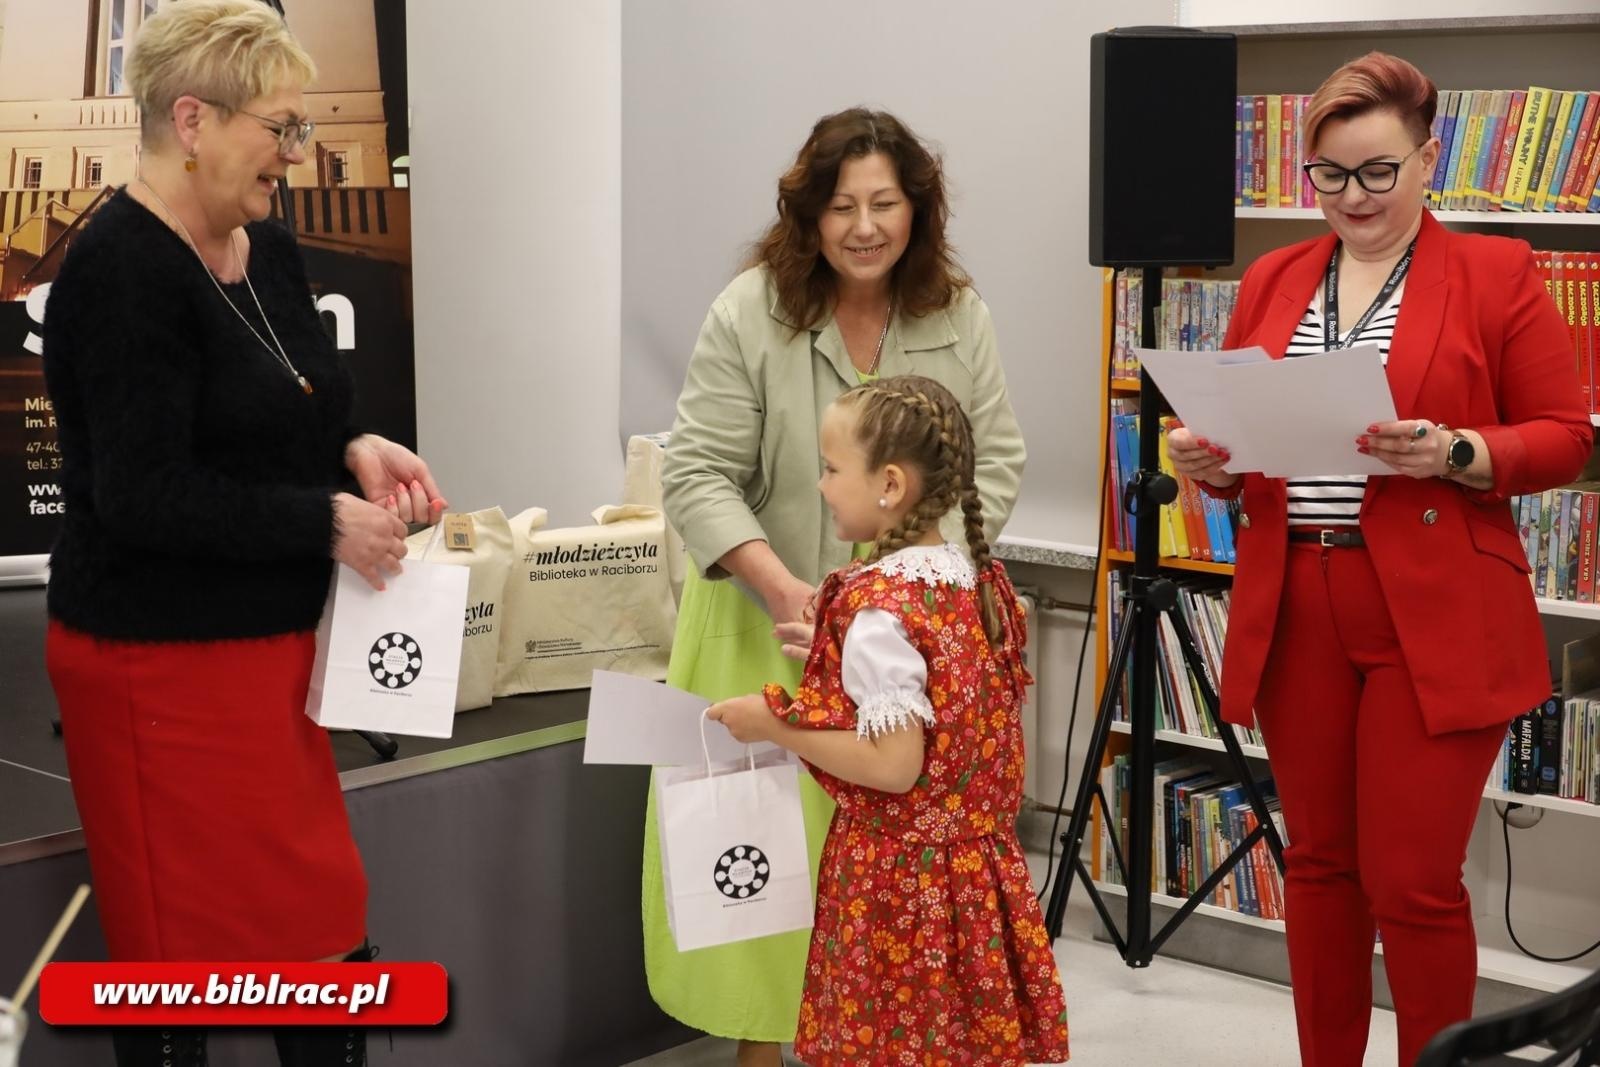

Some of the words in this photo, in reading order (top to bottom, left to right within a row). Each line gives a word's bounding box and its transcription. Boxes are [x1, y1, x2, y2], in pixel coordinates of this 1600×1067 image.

[25, 416, 47, 428] im.
[523, 542, 658, 566] #młodzieżczyta
[529, 567, 587, 582] Biblioteka
[589, 568, 599, 577] w
[601, 563, 658, 577] Raciborzu
[1520, 719, 1532, 760] MAFALDA
